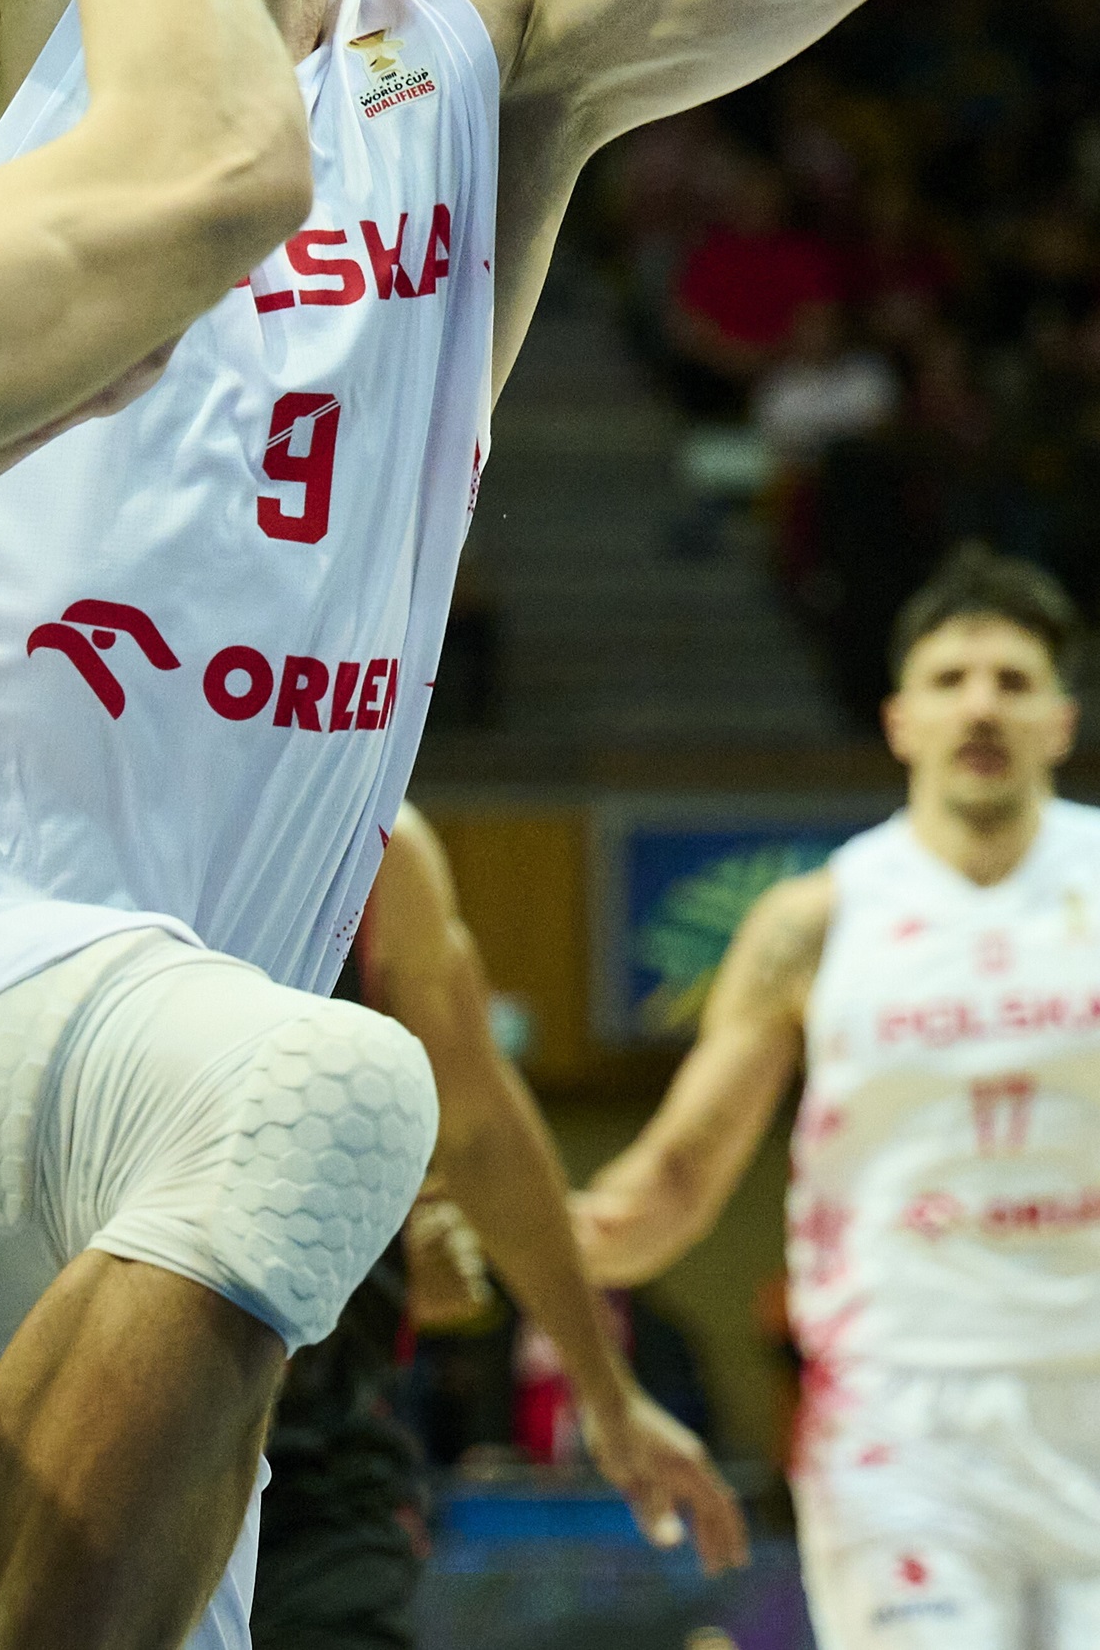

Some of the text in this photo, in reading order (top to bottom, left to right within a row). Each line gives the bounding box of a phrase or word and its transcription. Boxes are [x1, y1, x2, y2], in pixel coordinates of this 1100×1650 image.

[360, 71, 429, 106] WORLD CUP
[364, 80, 435, 118] QUALIFIERS
[256, 391, 341, 545] 9
